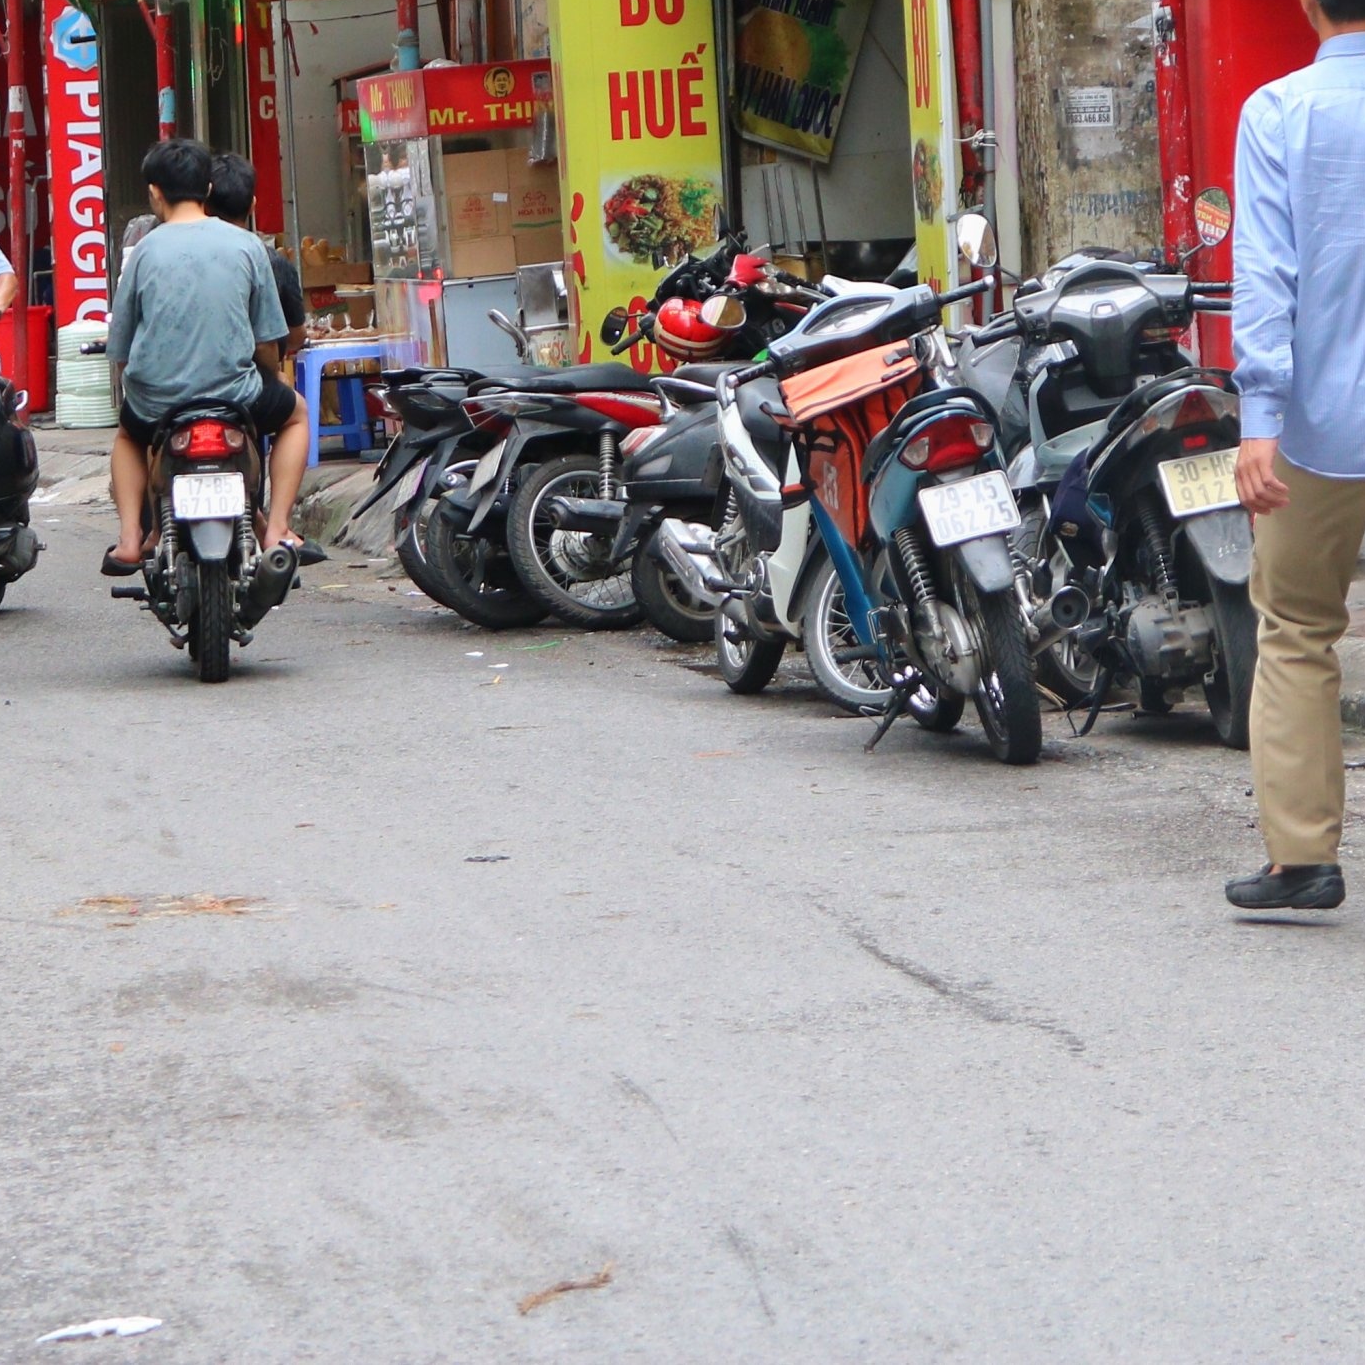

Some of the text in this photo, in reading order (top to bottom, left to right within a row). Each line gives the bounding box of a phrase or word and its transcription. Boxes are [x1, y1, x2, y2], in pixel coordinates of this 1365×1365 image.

[608, 43, 708, 141] HUẾ
[429, 108, 475, 127] Mr.
[1183, 477, 1237, 511] 912
